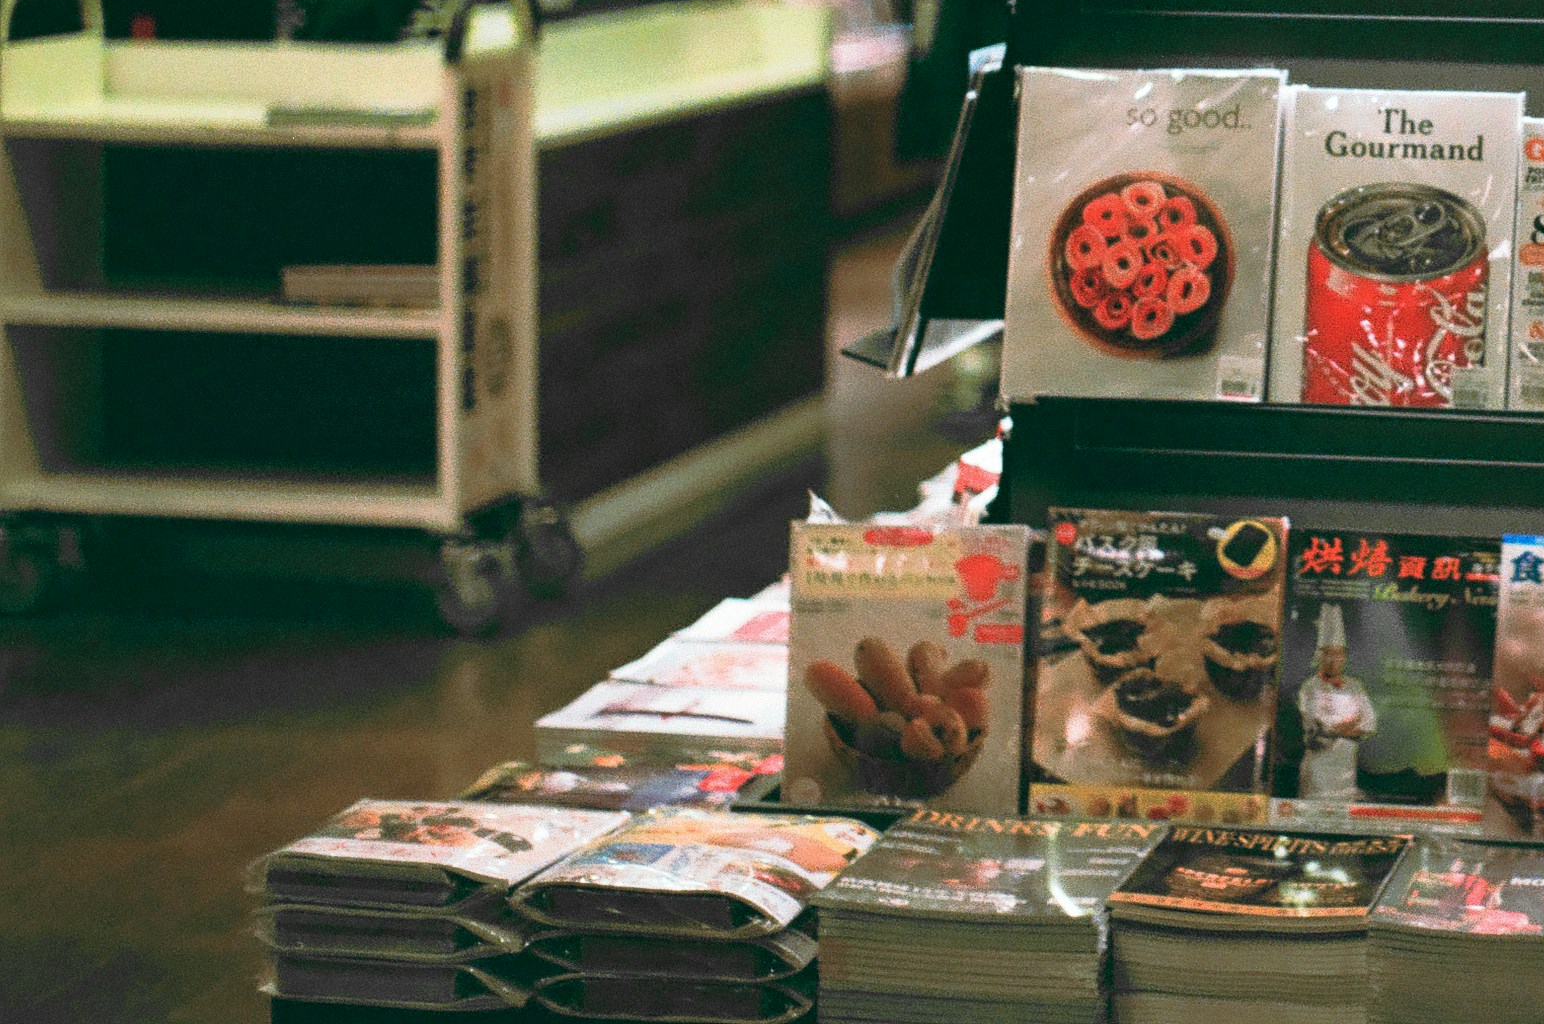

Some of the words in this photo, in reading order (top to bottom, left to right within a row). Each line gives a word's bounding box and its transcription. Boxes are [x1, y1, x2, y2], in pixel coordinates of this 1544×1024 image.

[1378, 109, 1434, 136] The
[1325, 130, 1484, 162] Gourmand
[1071, 823, 1156, 842] FUN
